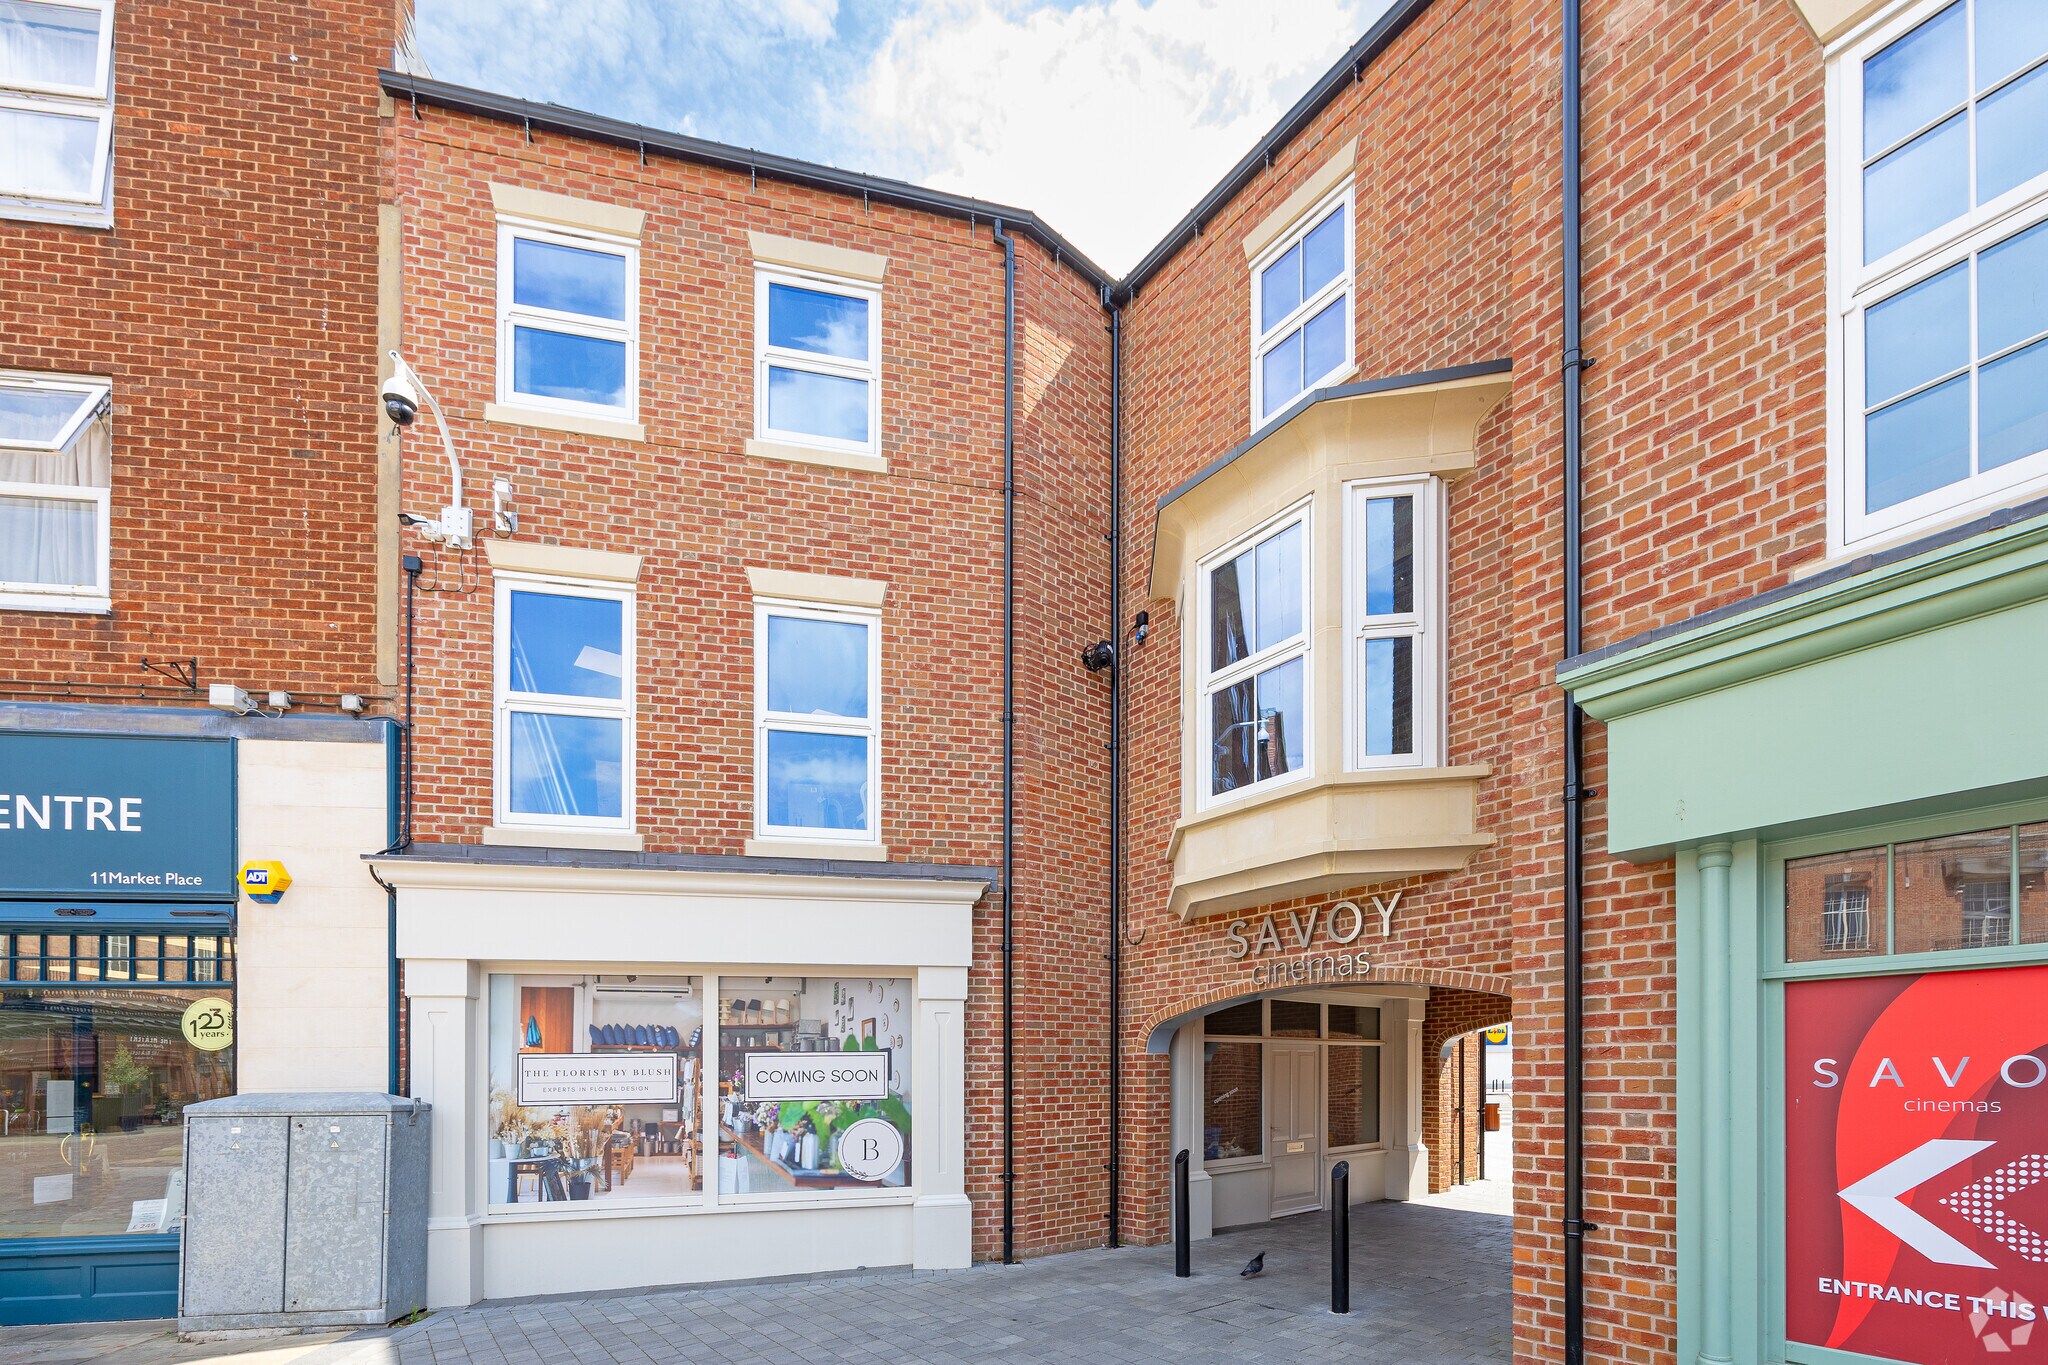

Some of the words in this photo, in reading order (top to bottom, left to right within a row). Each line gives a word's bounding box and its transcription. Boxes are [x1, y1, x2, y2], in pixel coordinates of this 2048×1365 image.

[165, 872, 202, 886] Place
[247, 871, 268, 883] ADT
[1227, 892, 1404, 959] SAVOY
[1251, 950, 1371, 986] cinemas
[190, 1008, 224, 1038] 123
[200, 1031, 225, 1040] years
[555, 1069, 608, 1077] FLORIST
[633, 1068, 672, 1076] BLUSH
[756, 1070, 826, 1083] COMING
[831, 1069, 878, 1083] SOON
[1812, 1054, 2047, 1088] SAVO
[1903, 1097, 2002, 1113] cinemas
[861, 1138, 880, 1161] B
[1818, 1277, 1961, 1312] ENTRANCE
[1966, 1296, 2036, 1321] THIS
